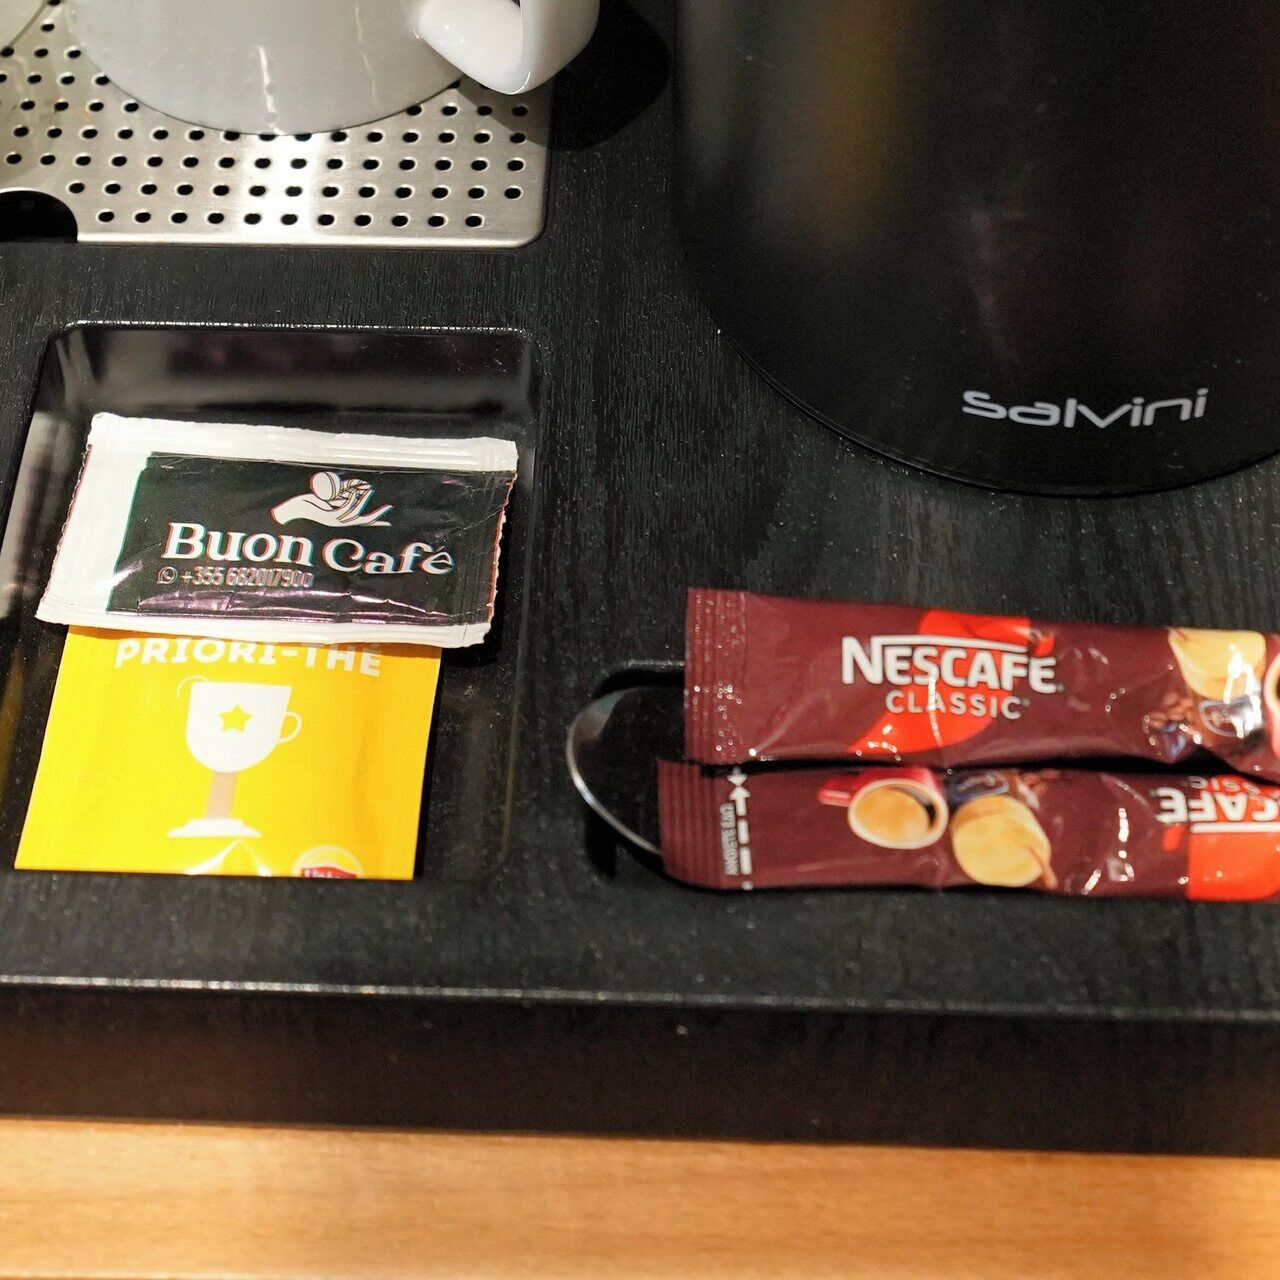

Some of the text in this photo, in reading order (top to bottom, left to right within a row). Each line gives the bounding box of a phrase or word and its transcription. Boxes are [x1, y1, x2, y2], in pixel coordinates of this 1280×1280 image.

[161, 522, 456, 575] Buon Café
[885, 689, 1022, 720] CLASSIC
